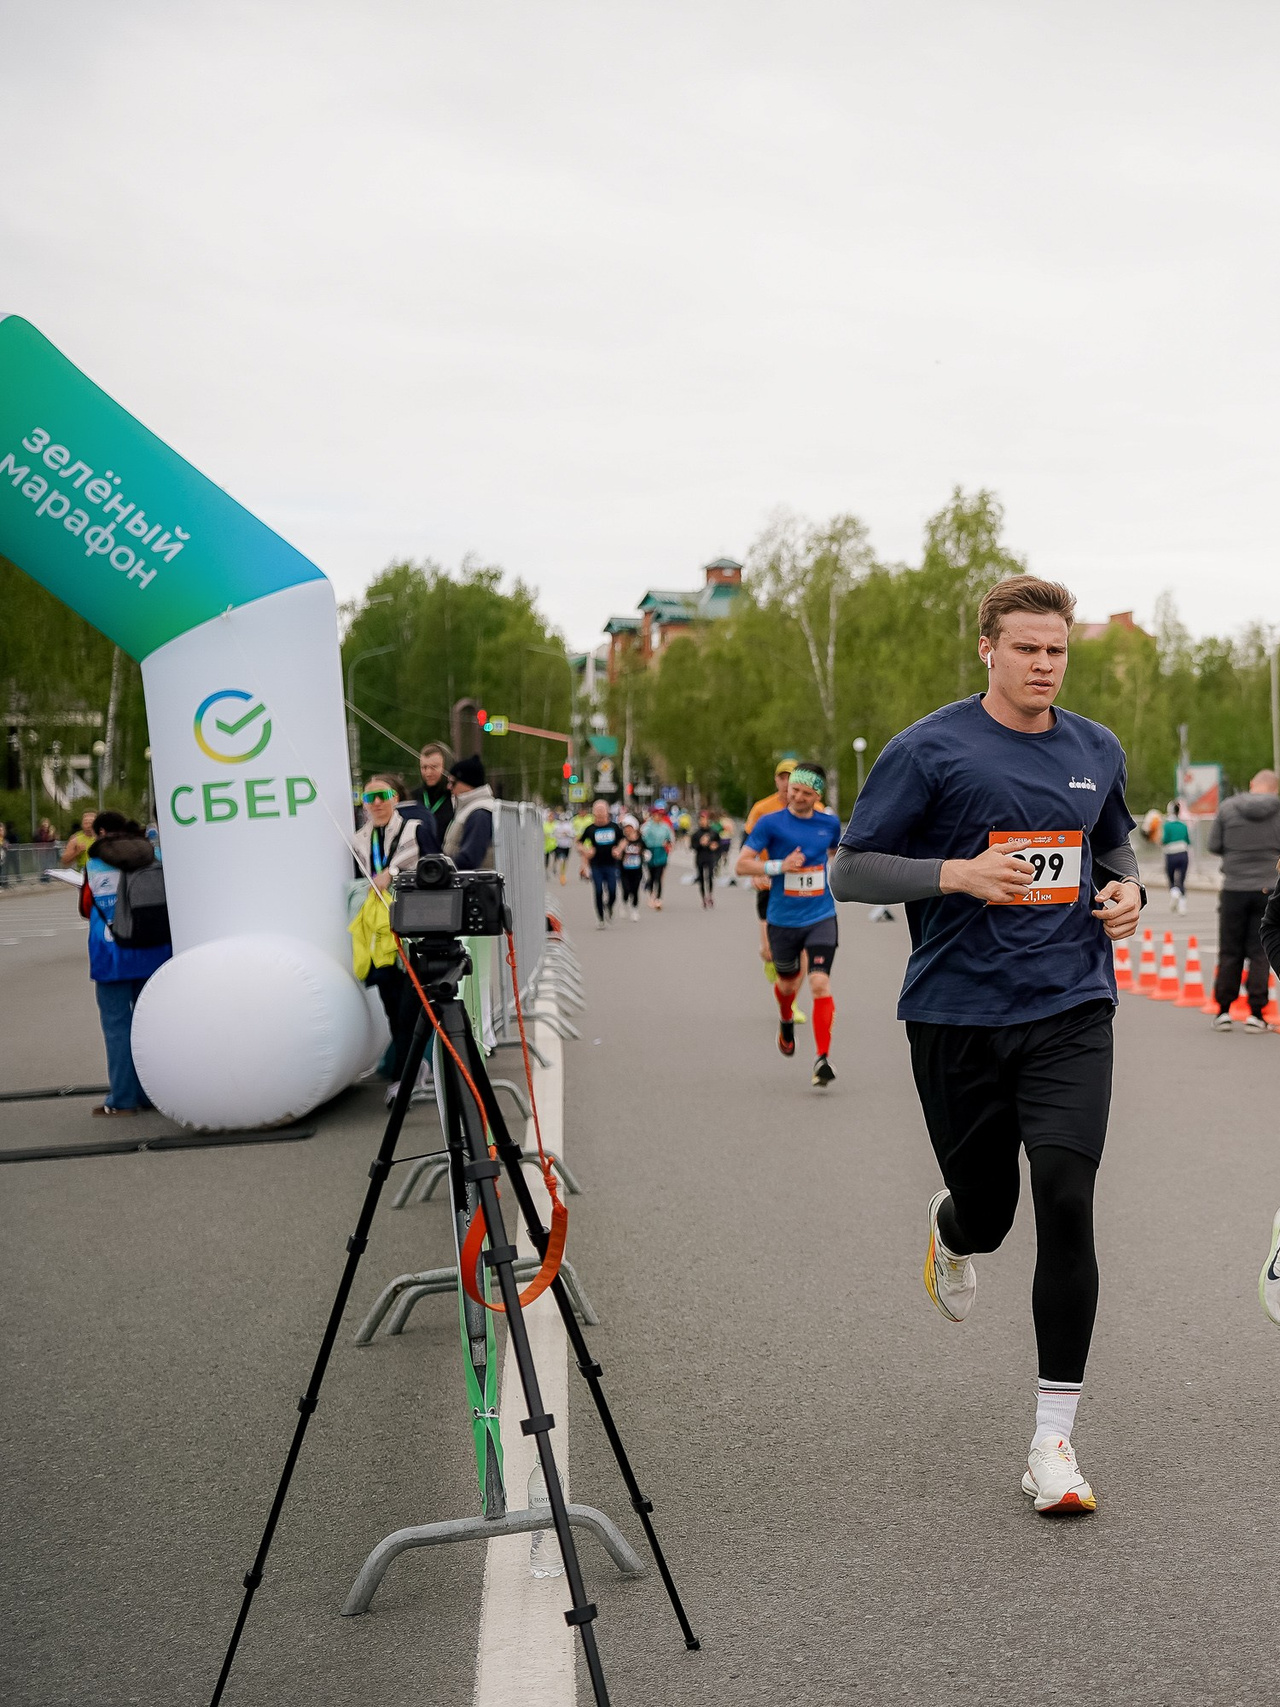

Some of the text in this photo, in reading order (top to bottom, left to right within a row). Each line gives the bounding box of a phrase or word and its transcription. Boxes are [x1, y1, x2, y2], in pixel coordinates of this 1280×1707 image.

[0, 452, 157, 590] марафон
[21, 426, 191, 563] зелёный
[170, 776, 318, 827] СБЕР
[1011, 853, 1064, 882] 99
